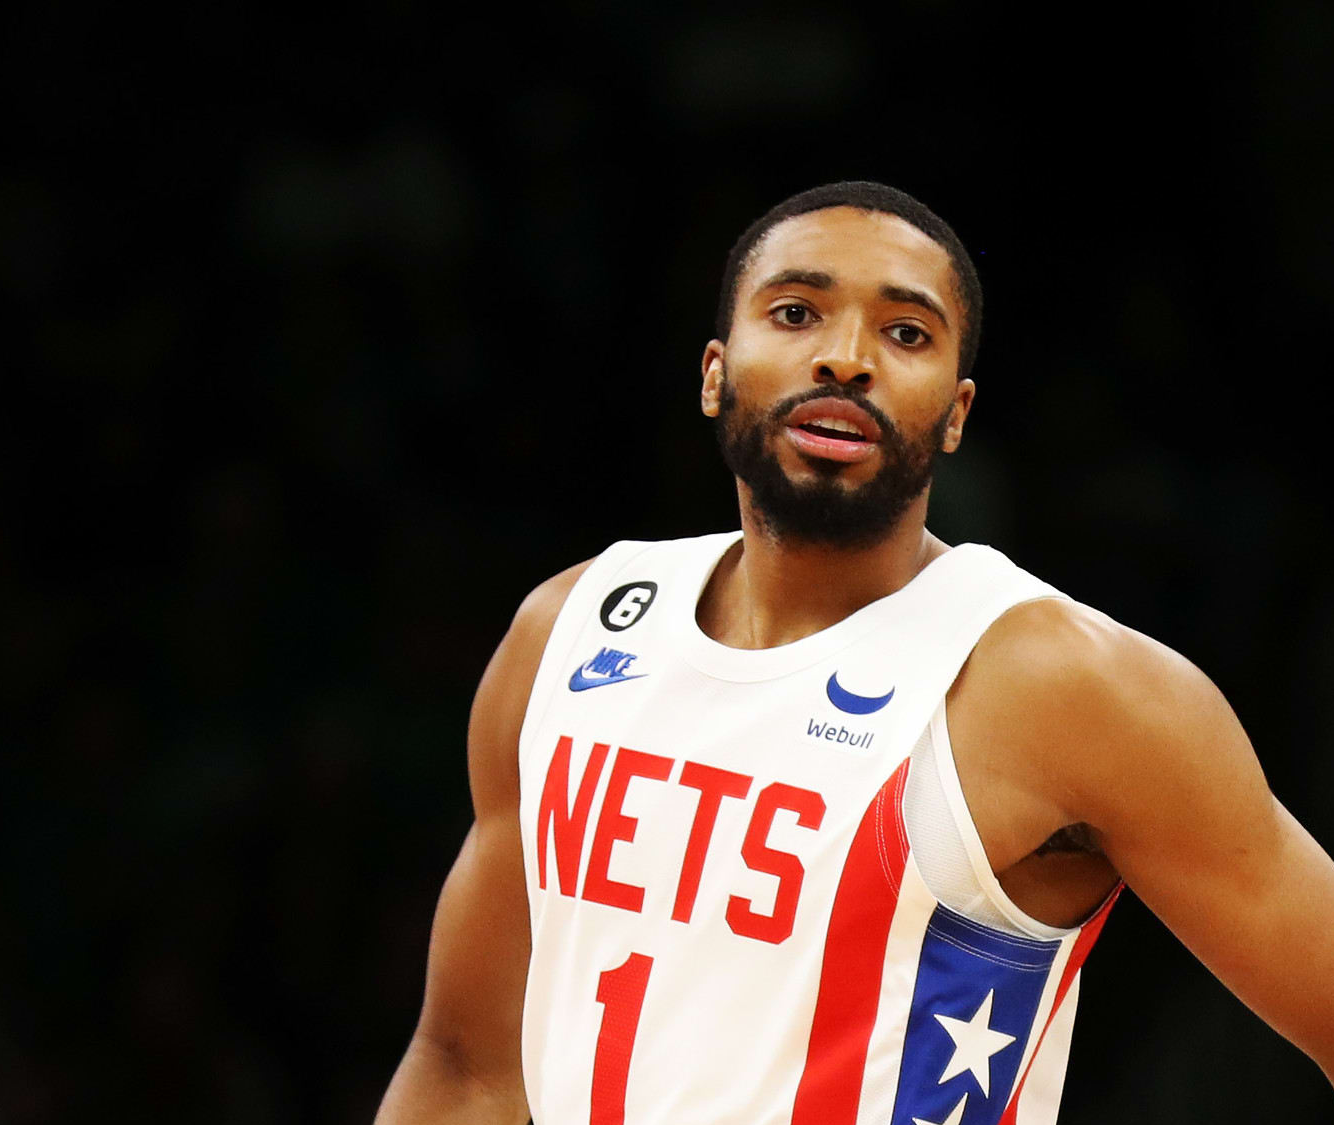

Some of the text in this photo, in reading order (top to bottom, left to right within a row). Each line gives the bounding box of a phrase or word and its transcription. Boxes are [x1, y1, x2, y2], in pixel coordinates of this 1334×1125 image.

[608, 586, 652, 628] 6
[584, 647, 638, 678] NIKE
[807, 718, 875, 749] Webull
[537, 735, 827, 945] NETS
